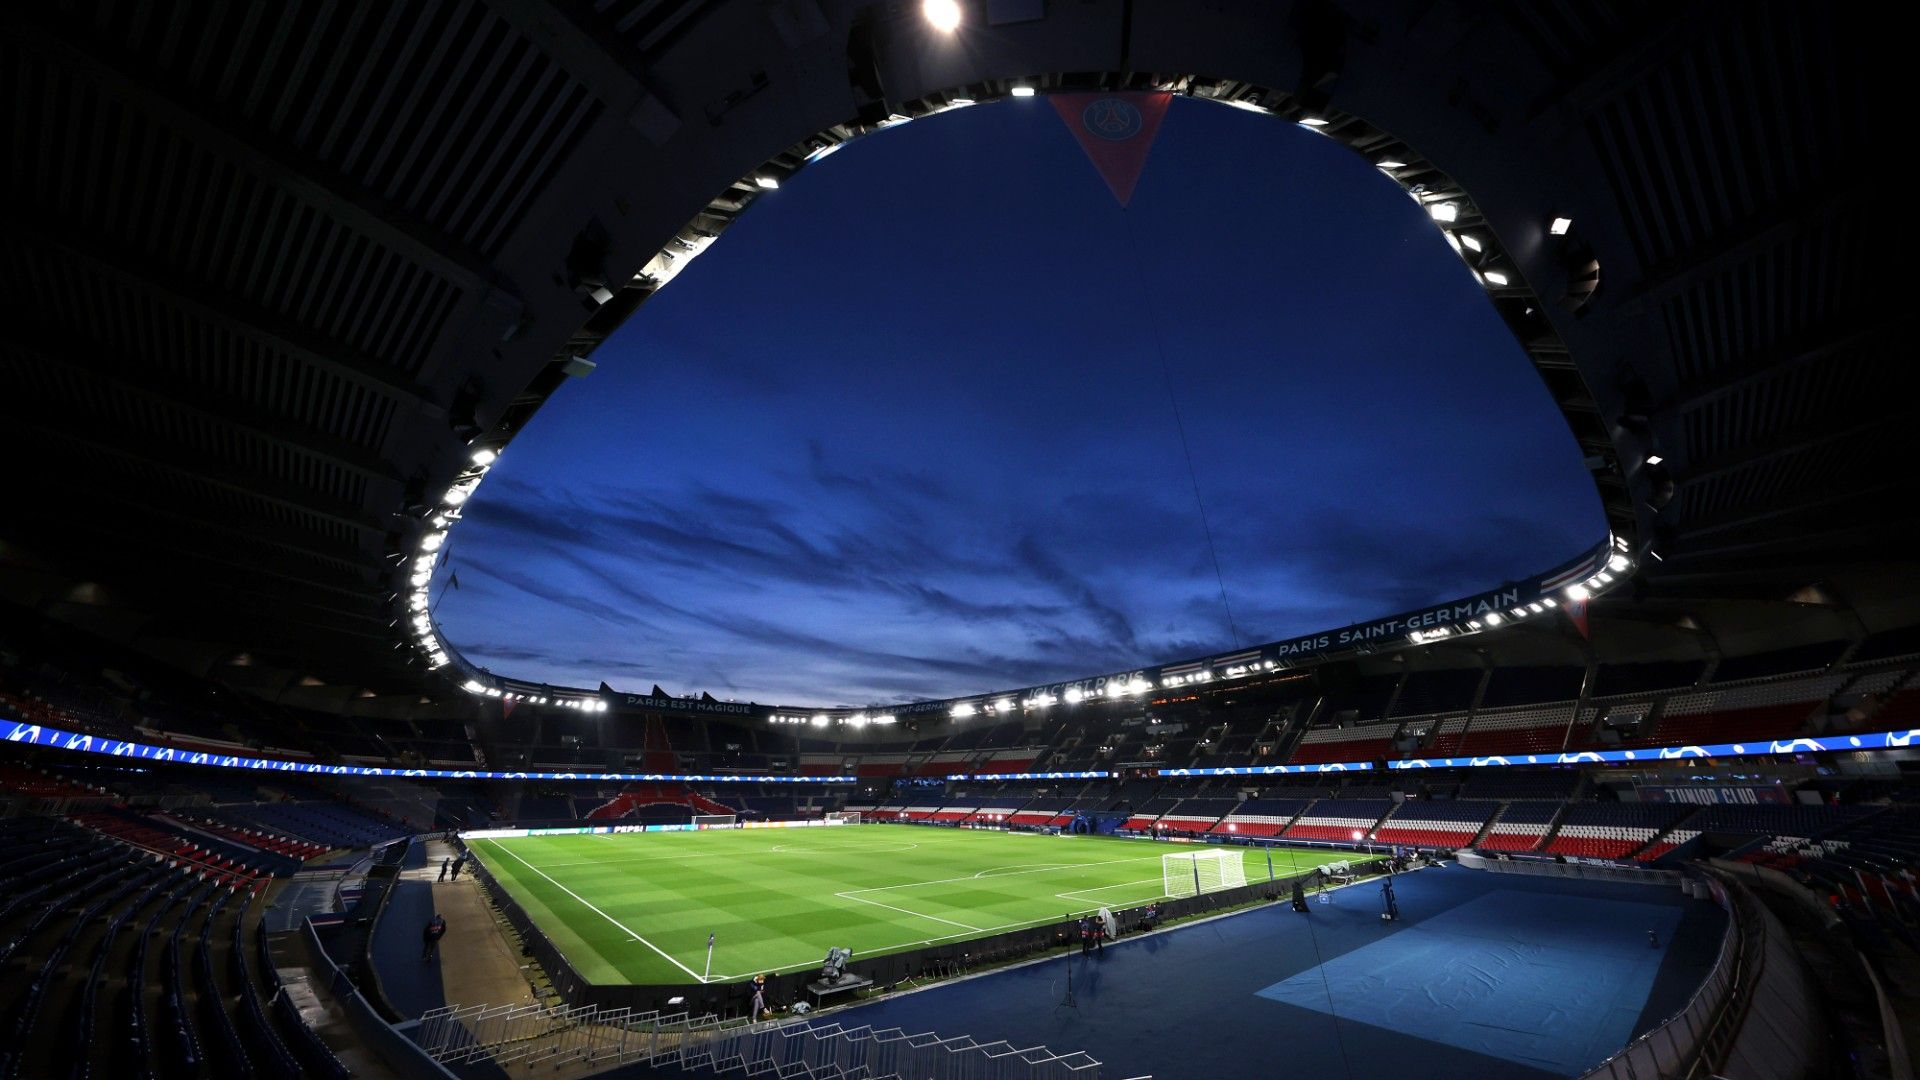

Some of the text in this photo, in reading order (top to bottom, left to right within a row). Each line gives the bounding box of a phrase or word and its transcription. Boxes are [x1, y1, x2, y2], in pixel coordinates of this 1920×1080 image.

[1278, 587, 1519, 656] PARIS SAINT-GERMAIN
[627, 696, 751, 714] PARIS EST MAGIQUE
